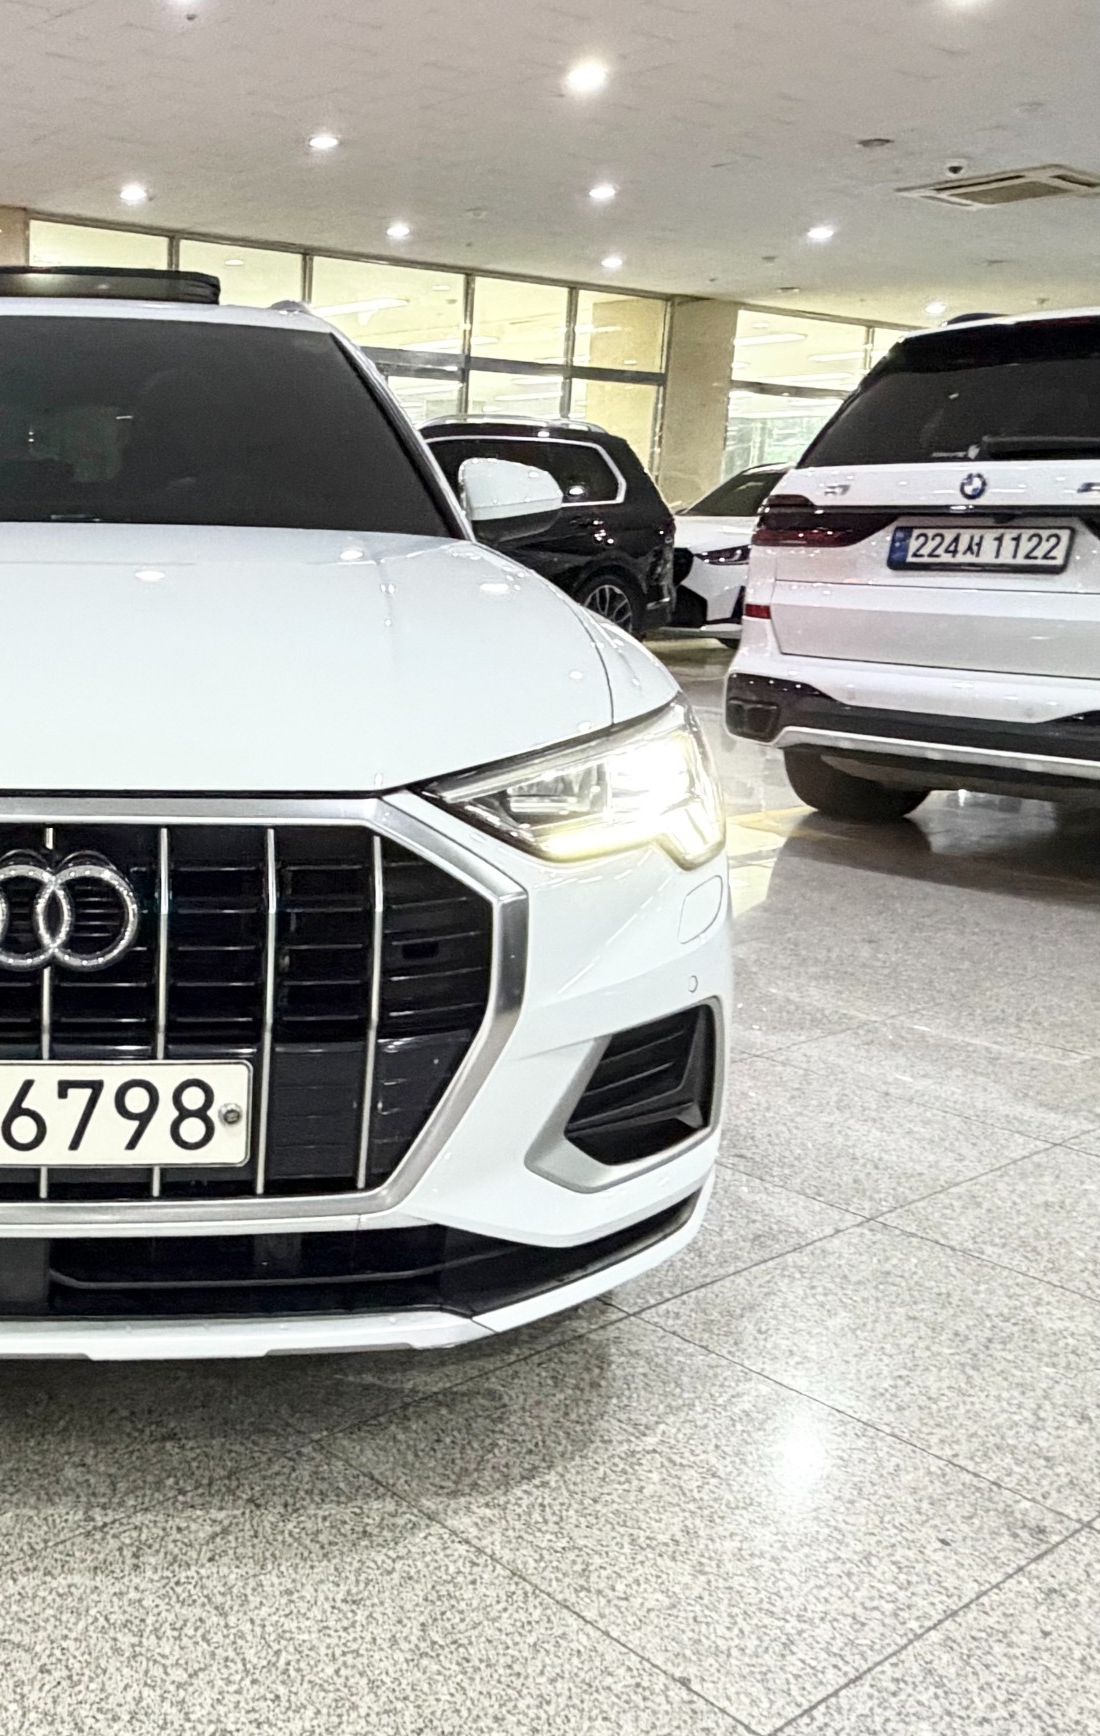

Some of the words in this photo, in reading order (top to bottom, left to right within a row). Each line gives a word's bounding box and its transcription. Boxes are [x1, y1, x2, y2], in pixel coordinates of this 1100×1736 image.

[911, 533, 984, 559] 224서
[993, 533, 1061, 560] 1122
[1, 1077, 216, 1152] 6798
